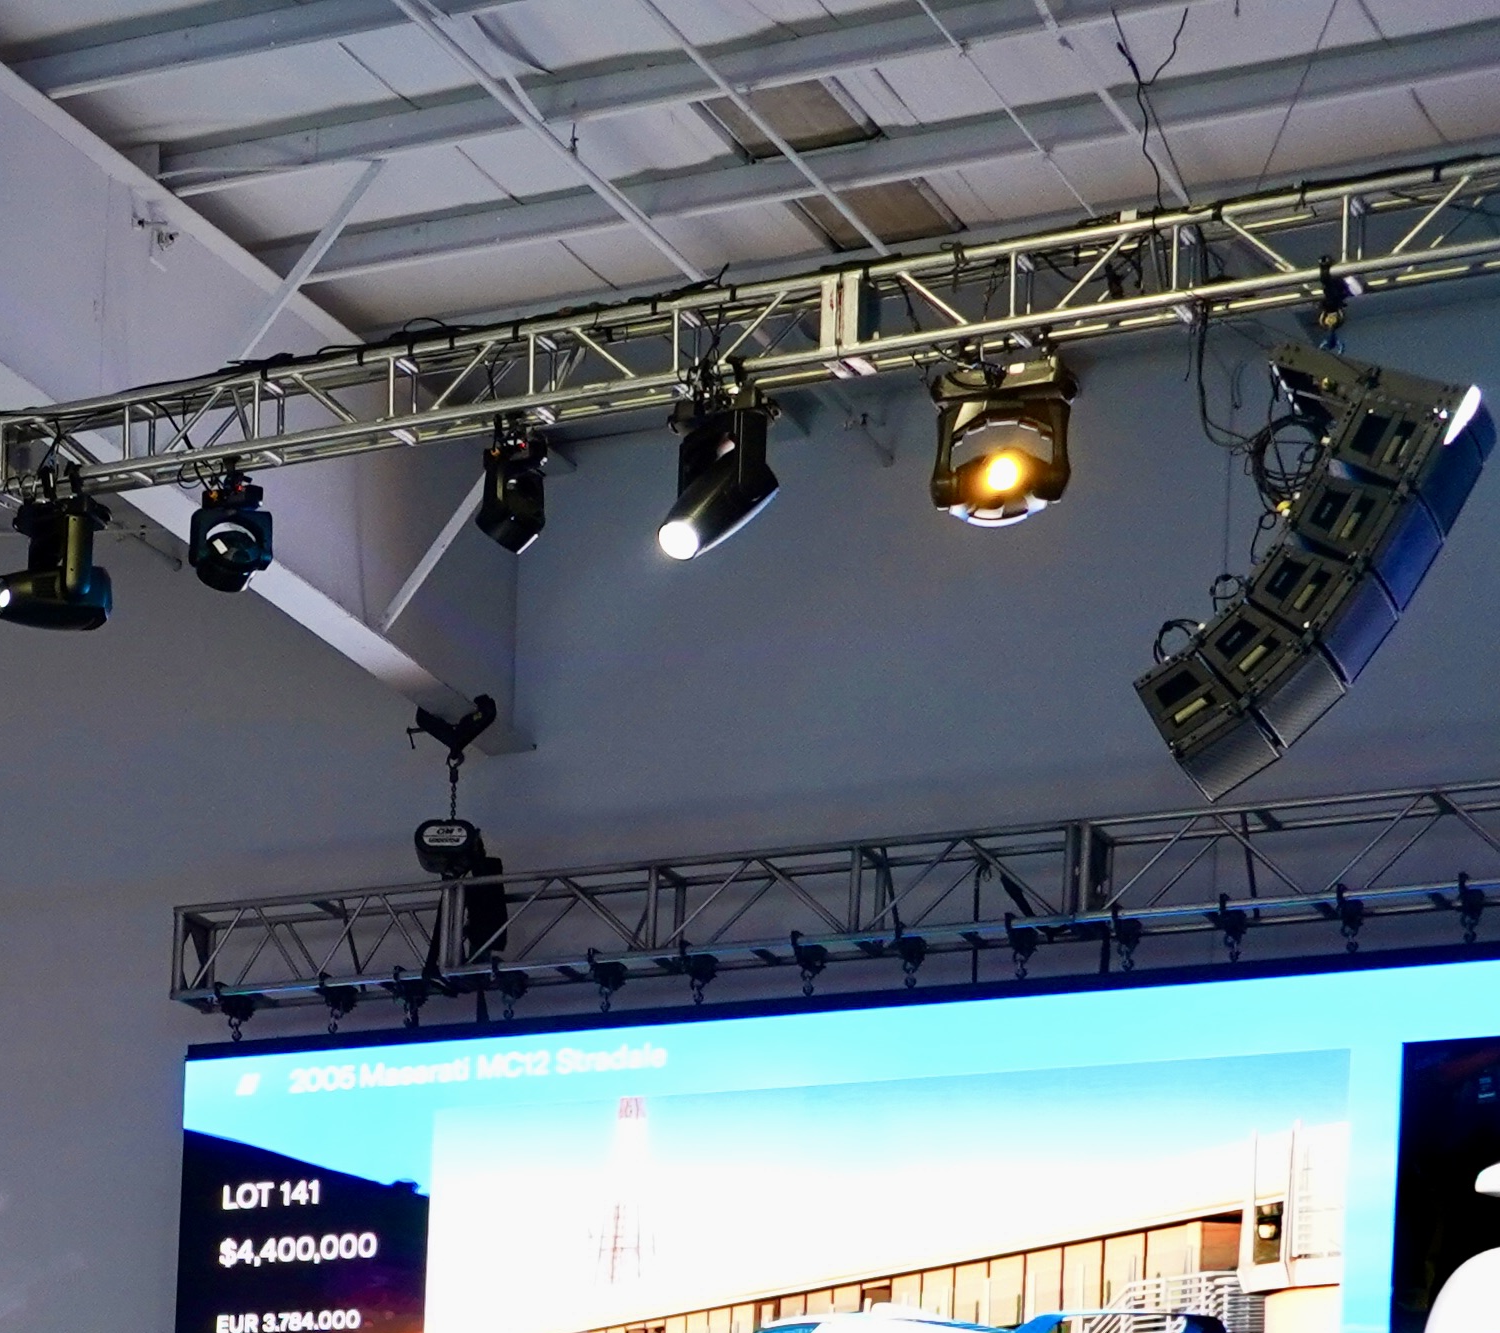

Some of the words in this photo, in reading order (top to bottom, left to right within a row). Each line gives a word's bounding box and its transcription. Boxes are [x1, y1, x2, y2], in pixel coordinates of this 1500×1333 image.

[360, 1056, 471, 1089] Maserati
[476, 1051, 551, 1080] MC12
[555, 1042, 668, 1076] Stradale
[221, 1182, 275, 1210] LOT
[279, 1179, 320, 1207] 141
[218, 1232, 378, 1268] $4,400,000
